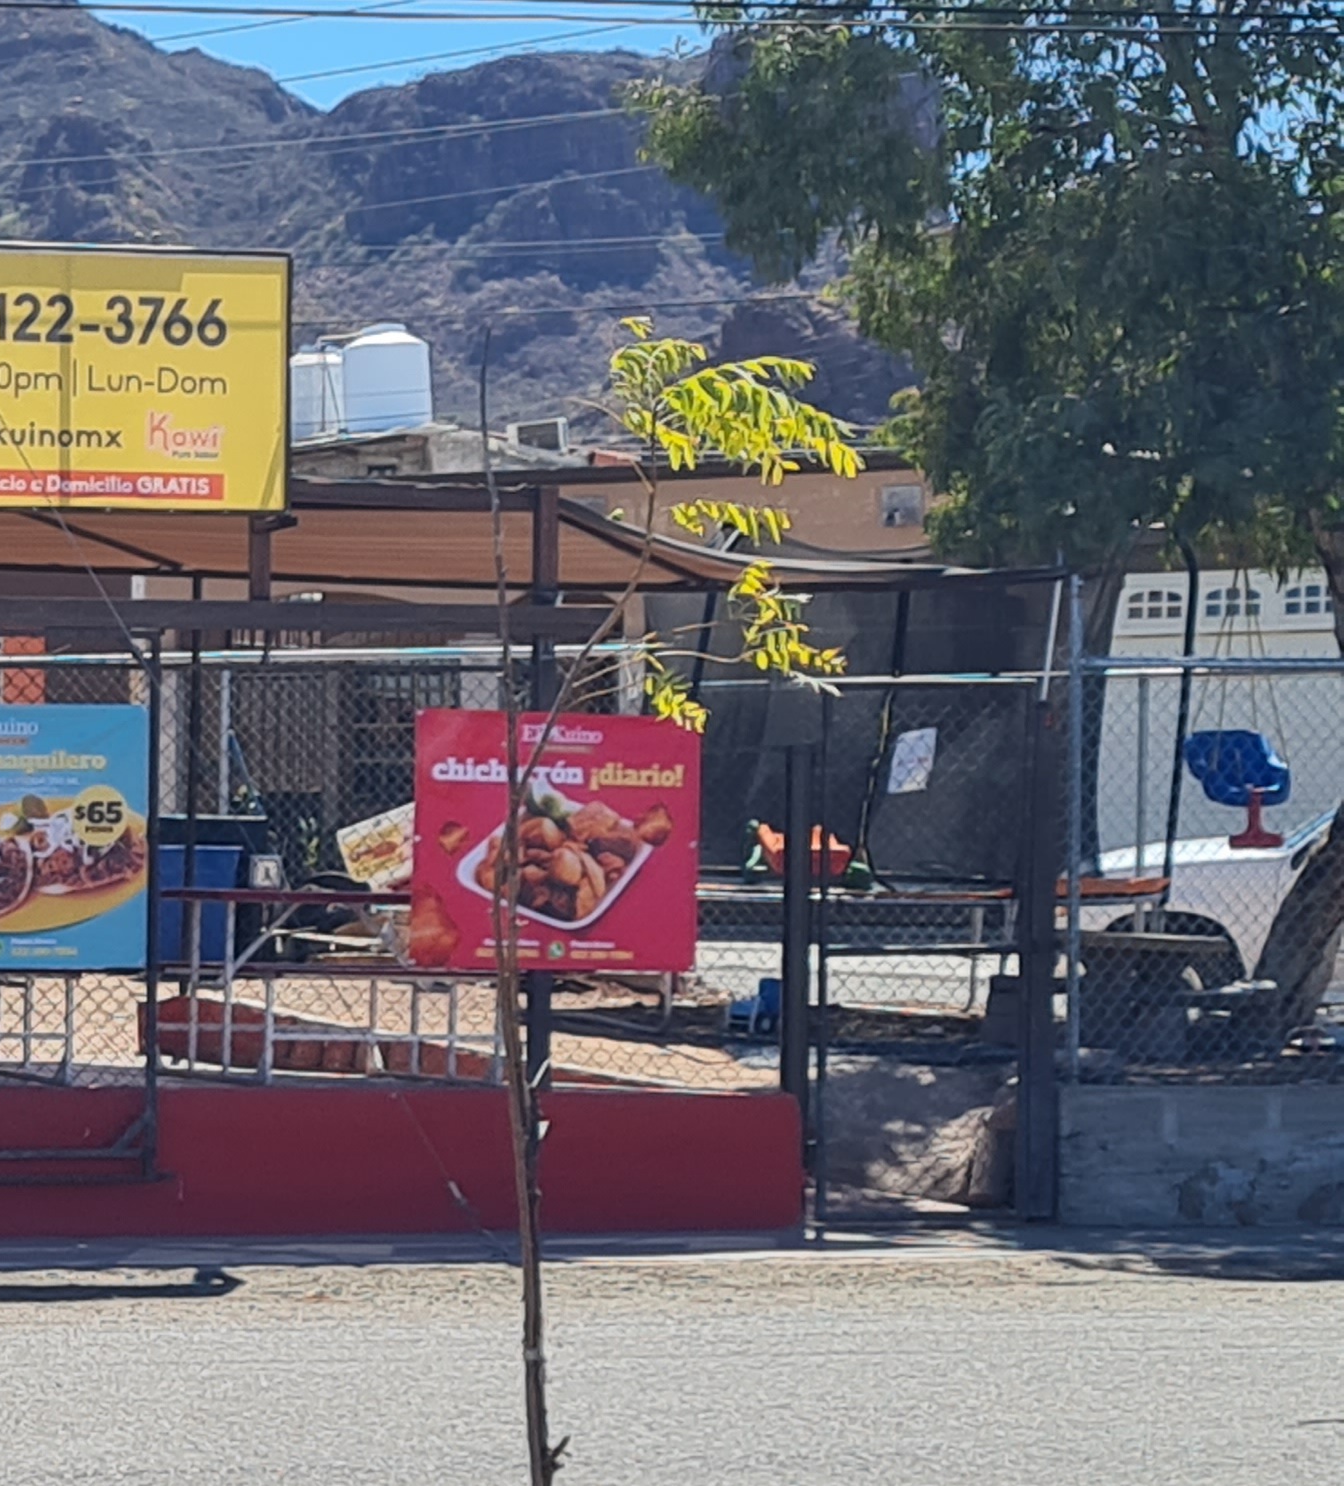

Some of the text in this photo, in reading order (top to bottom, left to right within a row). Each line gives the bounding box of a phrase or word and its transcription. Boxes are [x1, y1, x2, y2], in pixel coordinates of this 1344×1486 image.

[87, 364, 228, 396] Lun-Dom
[45, 473, 135, 494] Domicilio
[136, 475, 211, 495] GRATIS
[589, 761, 686, 791] ¡diario!
[73, 800, 123, 824] $65
